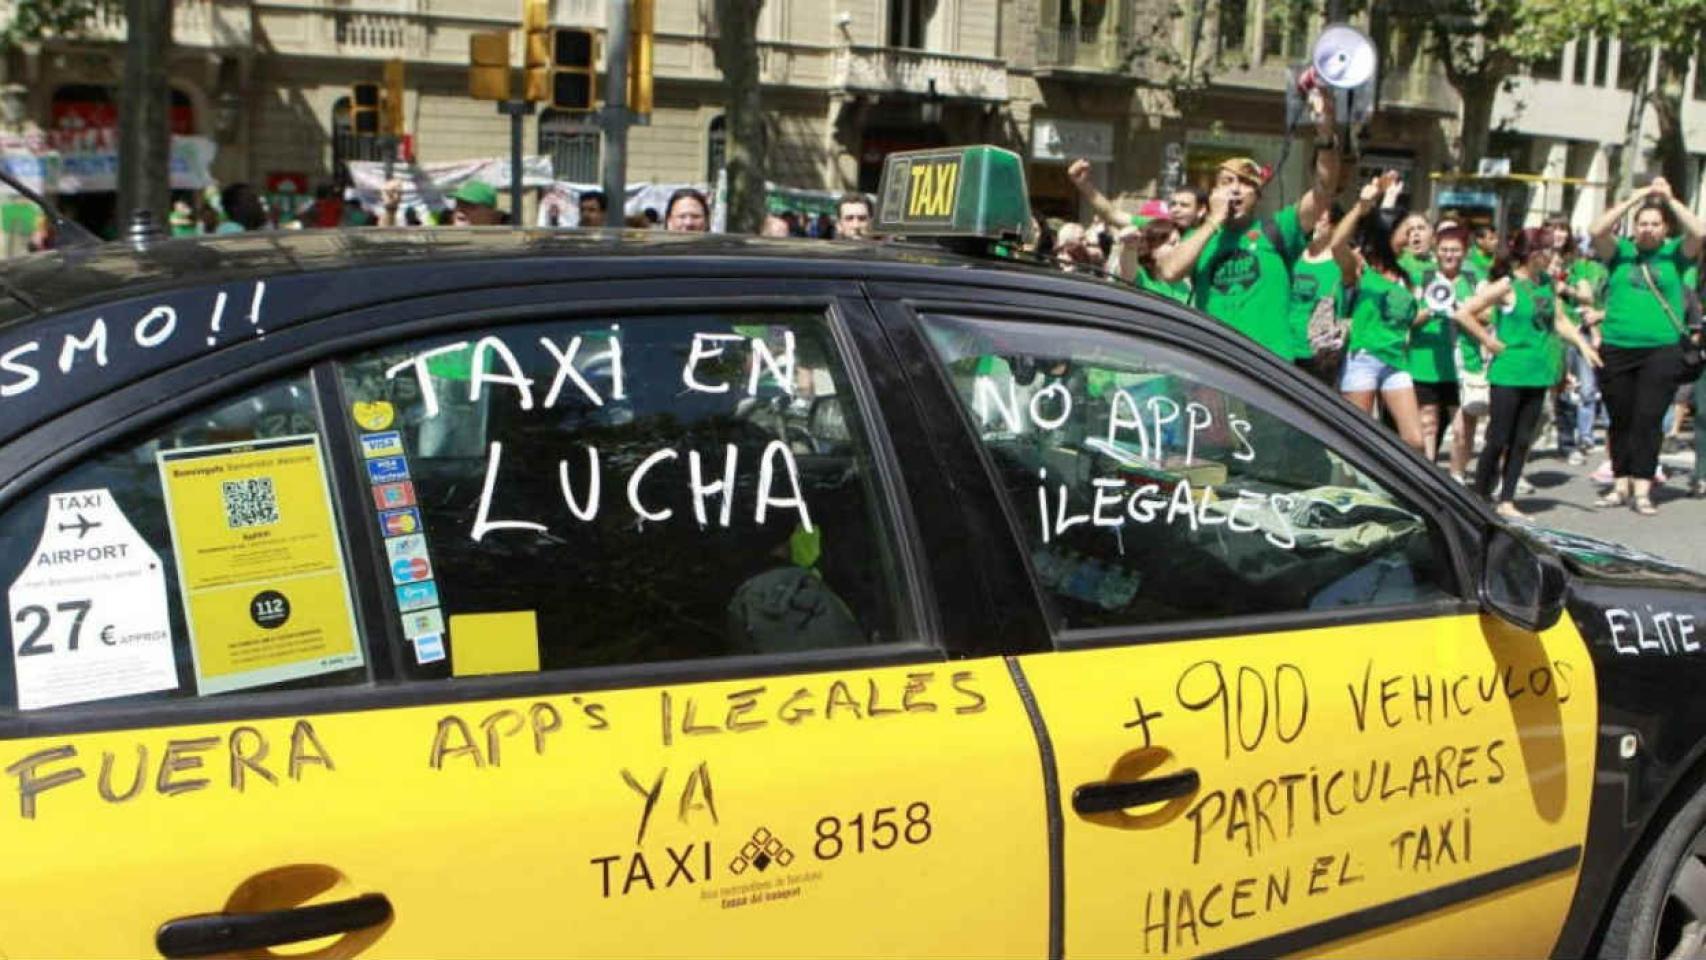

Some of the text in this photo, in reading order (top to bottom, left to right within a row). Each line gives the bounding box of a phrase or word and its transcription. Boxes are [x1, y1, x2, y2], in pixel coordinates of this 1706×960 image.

[908, 162, 958, 216] TAXI
[682, 330, 797, 396] EN
[972, 376, 1073, 434] NO
[369, 438, 395, 450] VISA
[57, 494, 102, 511] TAXI
[470, 440, 814, 542] LUCHA
[37, 543, 130, 566] AIRPORT
[15, 599, 93, 657] 27
[100, 625, 117, 646] €
[255, 598, 285, 616] 112
[1348, 658, 1575, 732] VEHICULOS
[5, 718, 336, 820] FUERA
[660, 671, 987, 746] ILEGALES
[620, 761, 720, 846] YA
[1185, 739, 1507, 864] PARTICULARES
[589, 801, 933, 899] TAXI 8158
[1143, 867, 1291, 954] HACEN
[1307, 852, 1363, 896] EL
